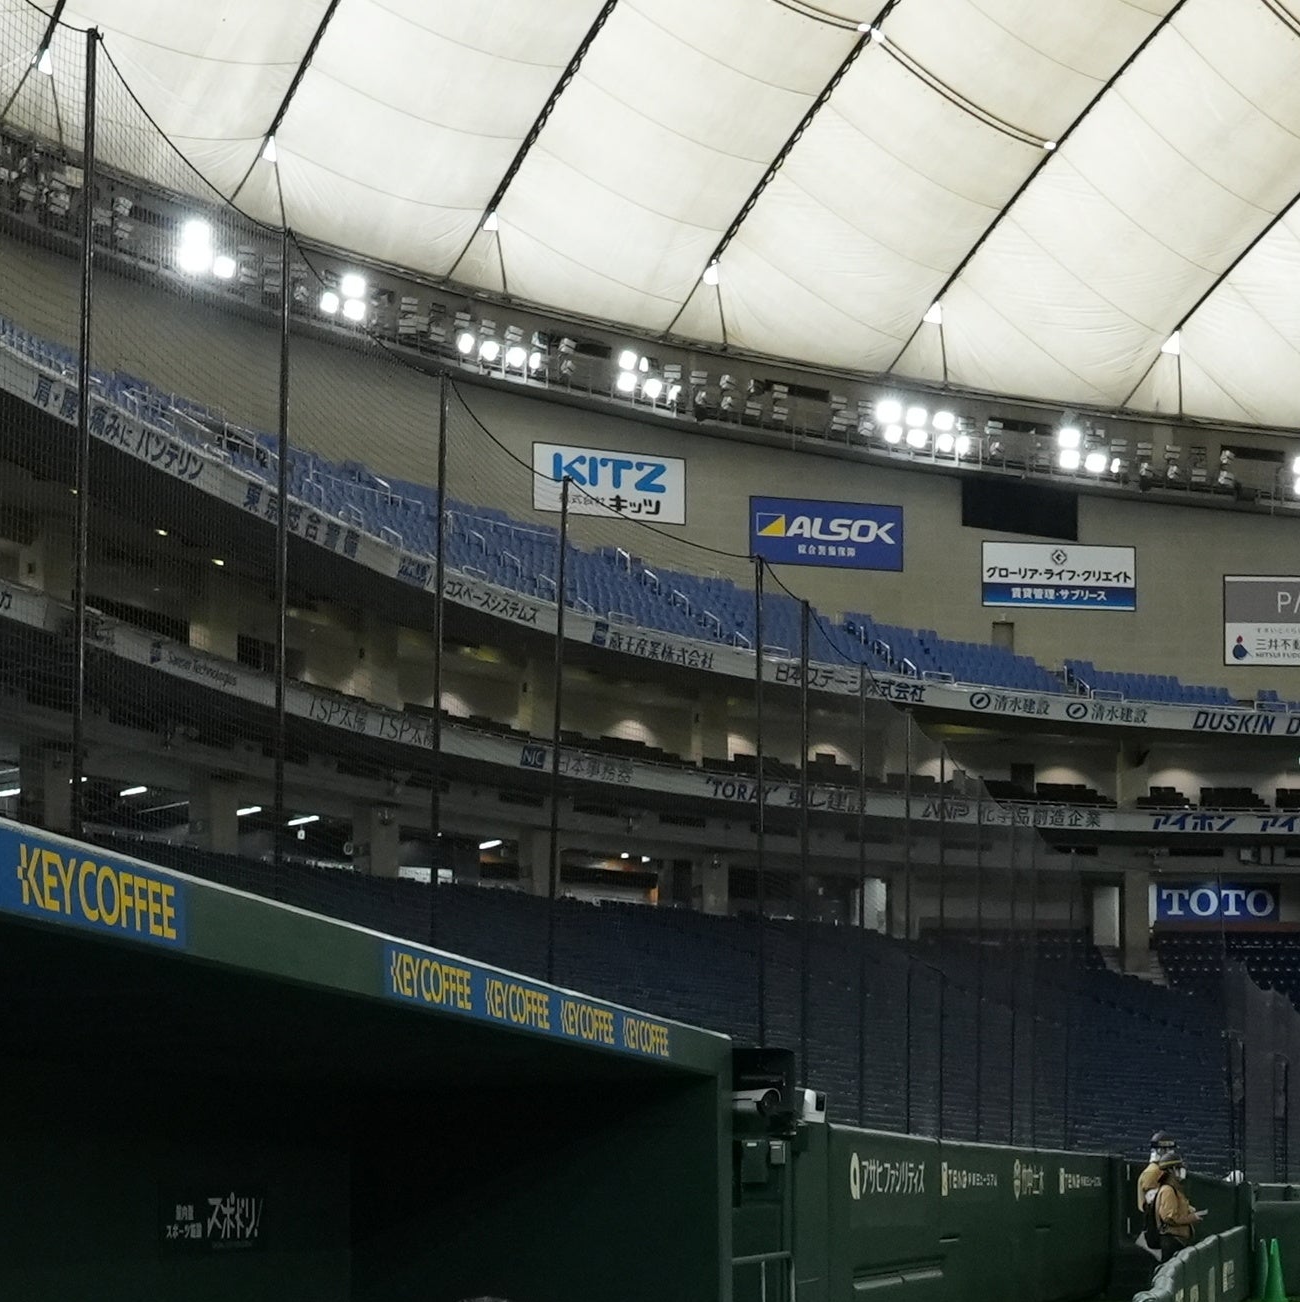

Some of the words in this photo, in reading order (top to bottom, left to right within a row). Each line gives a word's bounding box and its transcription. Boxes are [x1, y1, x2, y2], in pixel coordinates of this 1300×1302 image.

[553, 453, 666, 493] KITZ
[609, 495, 661, 515] キッツ
[786, 516, 896, 545] ALSOK
[986, 566, 1132, 584] グローリア・ライフ・クリエイト
[994, 694, 1050, 716] 清水建設
[1091, 703, 1148, 724] 清水建設
[1150, 813, 1237, 831] アイホン
[1162, 888, 1276, 917] TOTO
